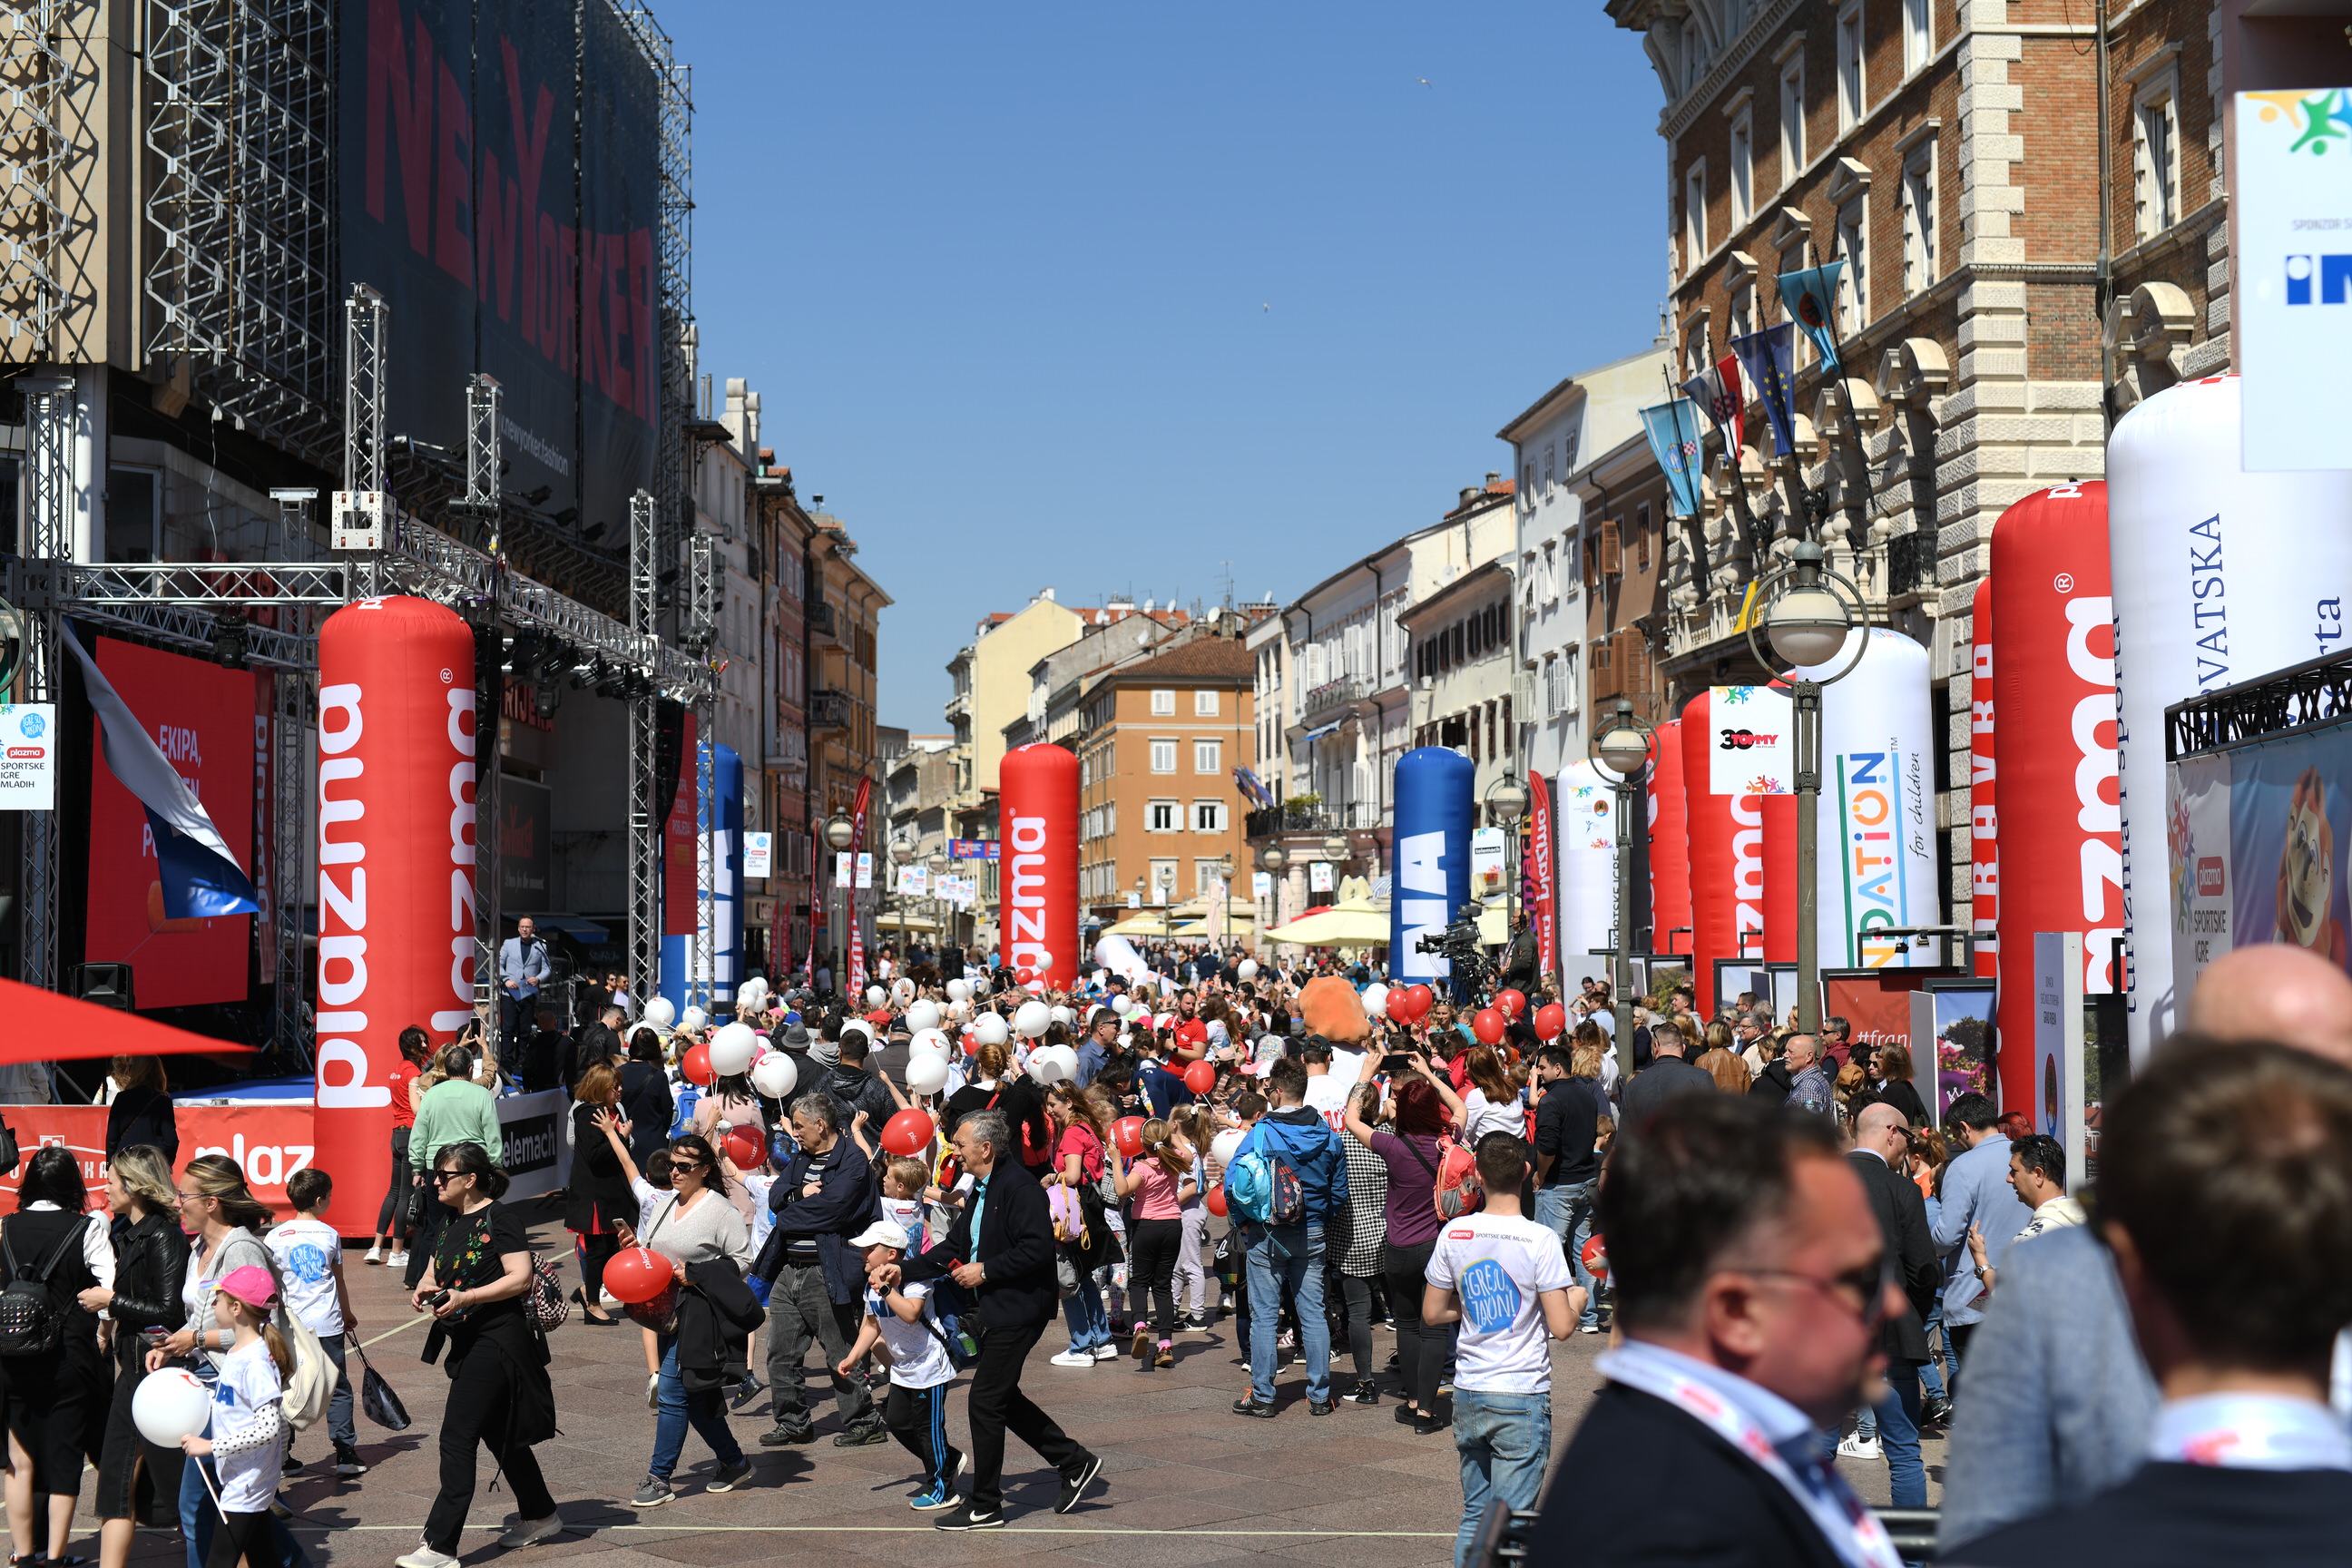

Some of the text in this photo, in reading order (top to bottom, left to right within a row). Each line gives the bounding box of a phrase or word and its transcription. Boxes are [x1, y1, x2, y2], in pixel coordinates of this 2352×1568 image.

[1730, 733, 1779, 745] TOMMY
[10, 749, 41, 758] plazma
[0, 762, 45, 770] SPORTSKE
[0, 771, 20, 779] IGRE
[0, 780, 35, 789] MLADIH
[1907, 752, 1929, 859] for children
[2200, 863, 2222, 891] plazma
[318, 683, 391, 1108] plazma
[2194, 910, 2227, 934] SPORTSKE
[2194, 940, 2210, 964] IGRE
[194, 1132, 315, 1186] laz
[501, 1129, 556, 1168] elemach
